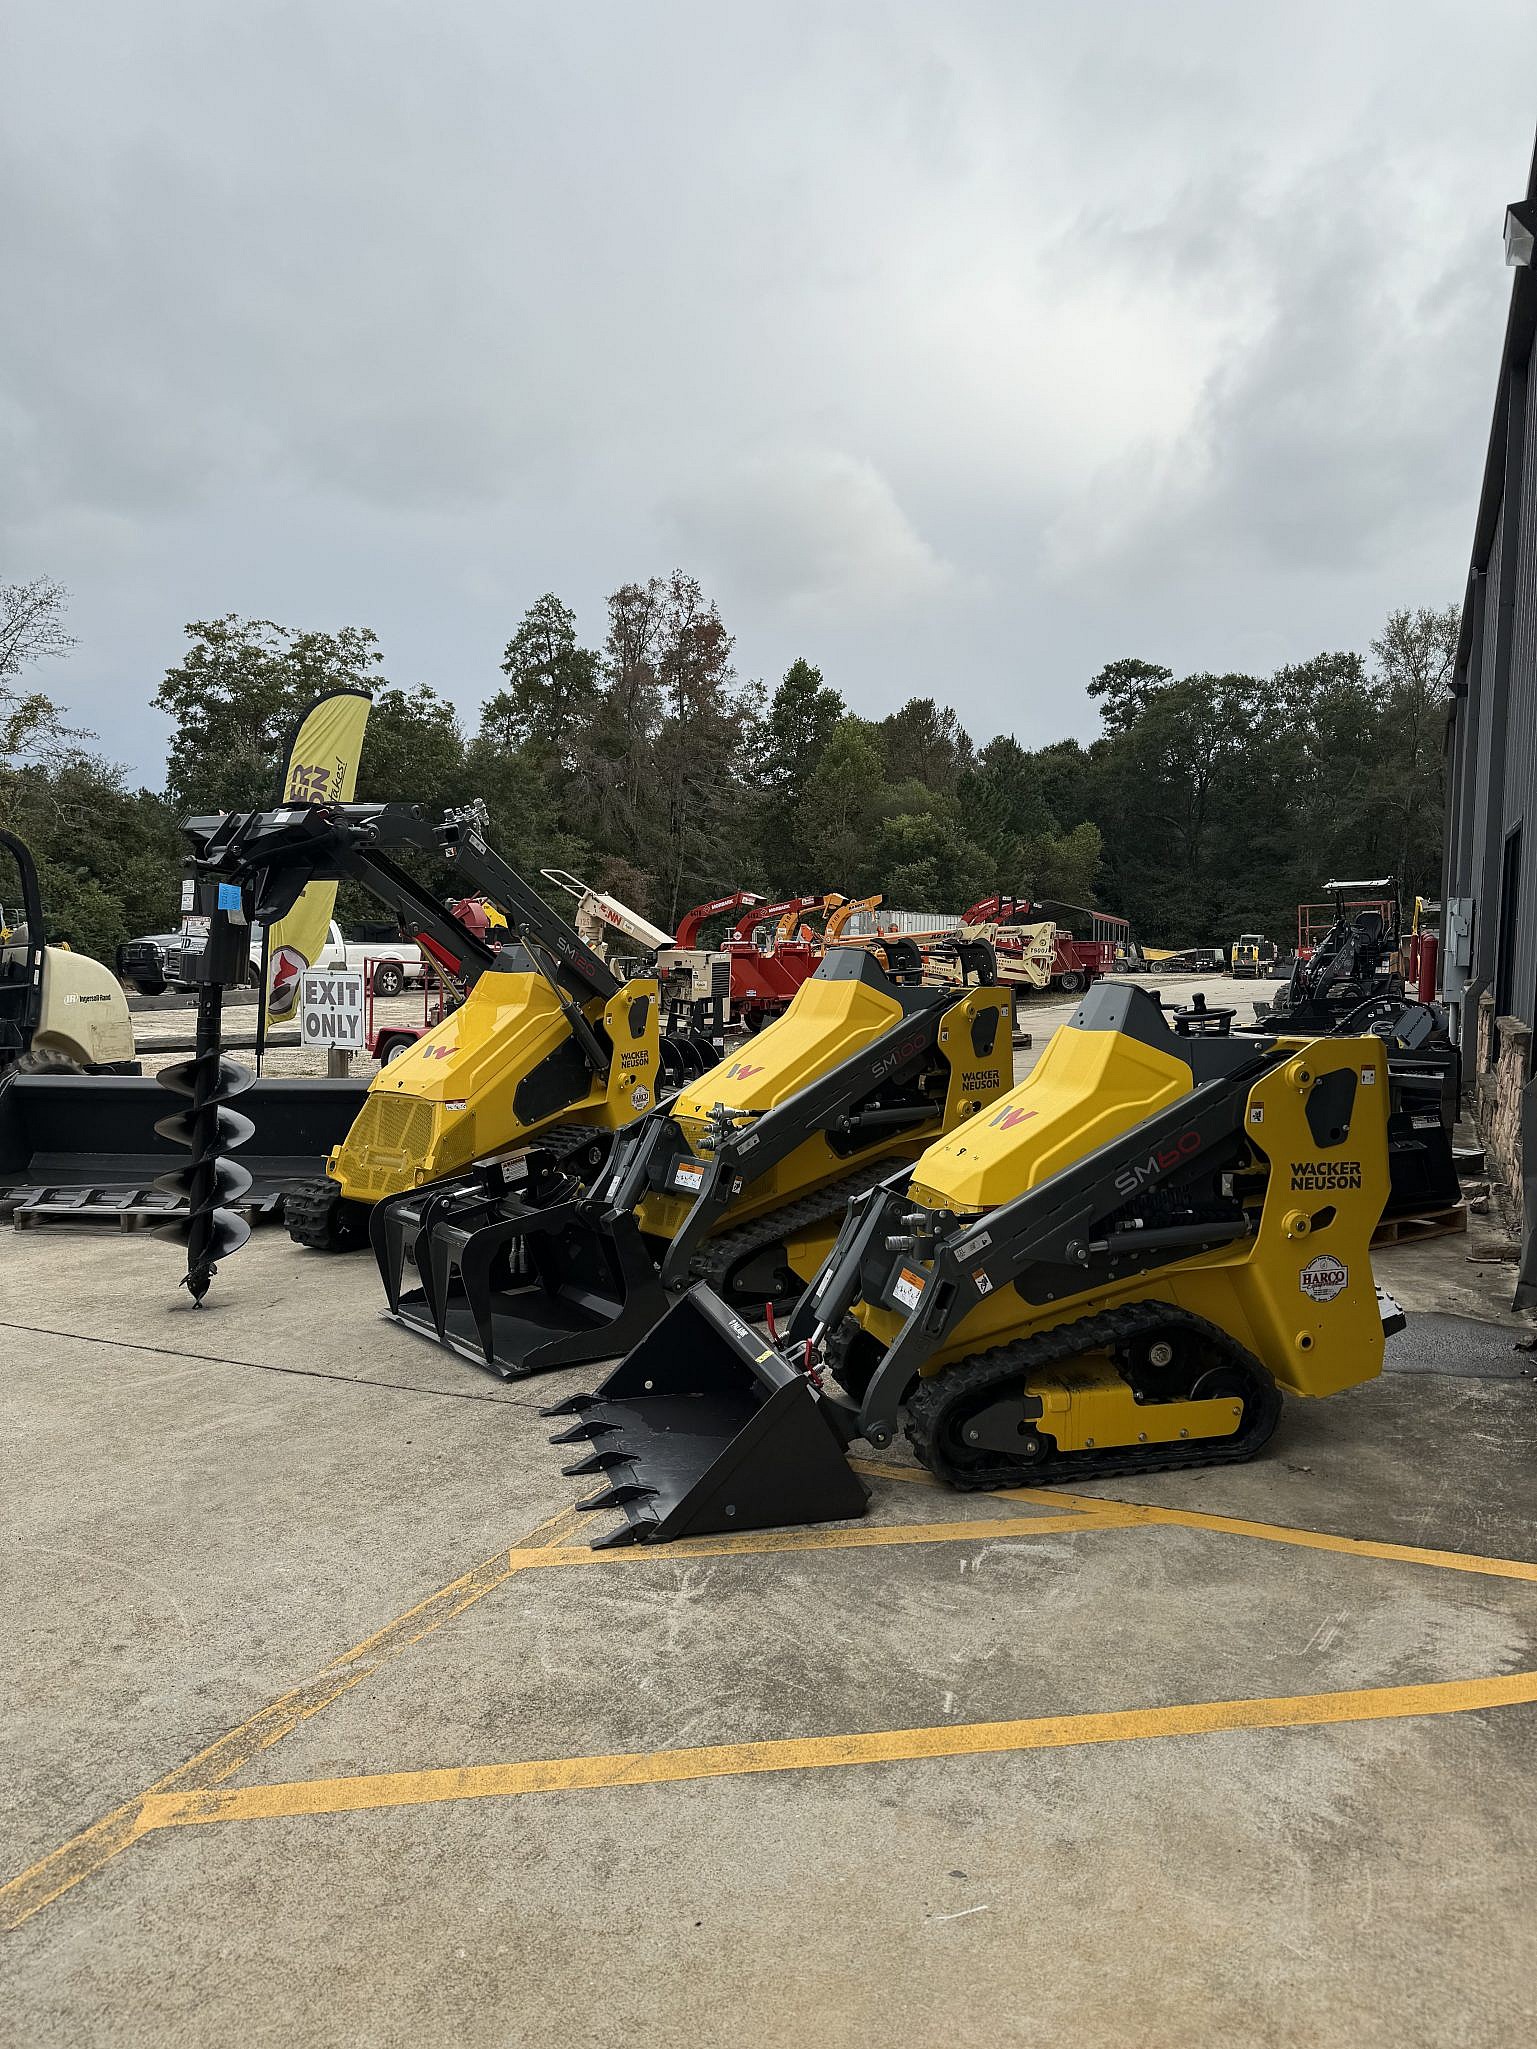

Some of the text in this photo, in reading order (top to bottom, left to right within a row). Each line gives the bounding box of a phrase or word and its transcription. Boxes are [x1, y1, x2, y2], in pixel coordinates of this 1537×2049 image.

[305, 980, 360, 1006] EXIT
[305, 1012, 360, 1039] ONLY
[620, 1050, 649, 1061] WACKER
[621, 1058, 649, 1069] NEUSON
[961, 1069, 1000, 1082] WACKER
[961, 1079, 1000, 1092] NEUSON
[1114, 1132, 1201, 1196] SM60
[1290, 1161, 1362, 1177] WACKER
[1290, 1175, 1362, 1191] NEUSON
[1302, 1270, 1345, 1285] HARCO
